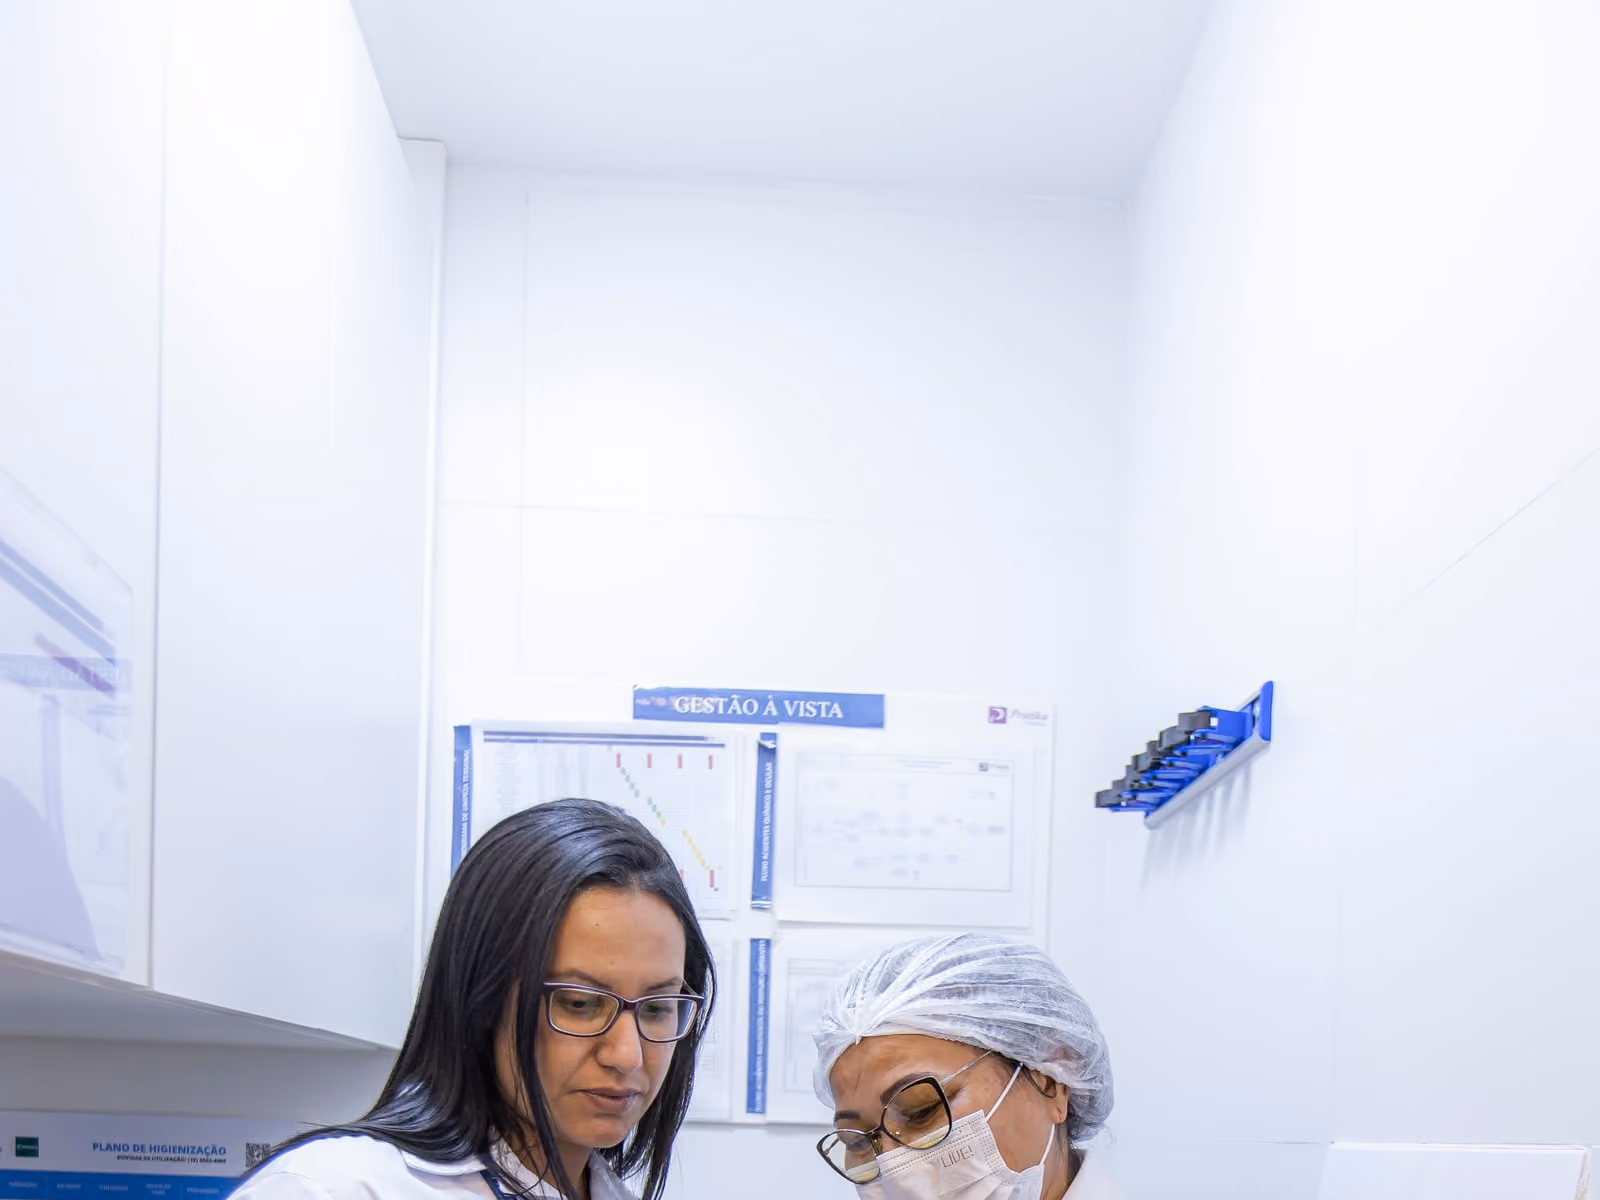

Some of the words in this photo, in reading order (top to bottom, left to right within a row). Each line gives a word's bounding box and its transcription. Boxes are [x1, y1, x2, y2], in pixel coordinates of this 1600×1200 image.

[675, 695, 759, 716] GESTÃO
[762, 695, 778, 716] À
[784, 700, 844, 719] VISTA
[92, 1142, 130, 1153] PLANO
[133, 1144, 145, 1154] DE
[149, 1143, 227, 1158] HIGIENIZAÇÃO
